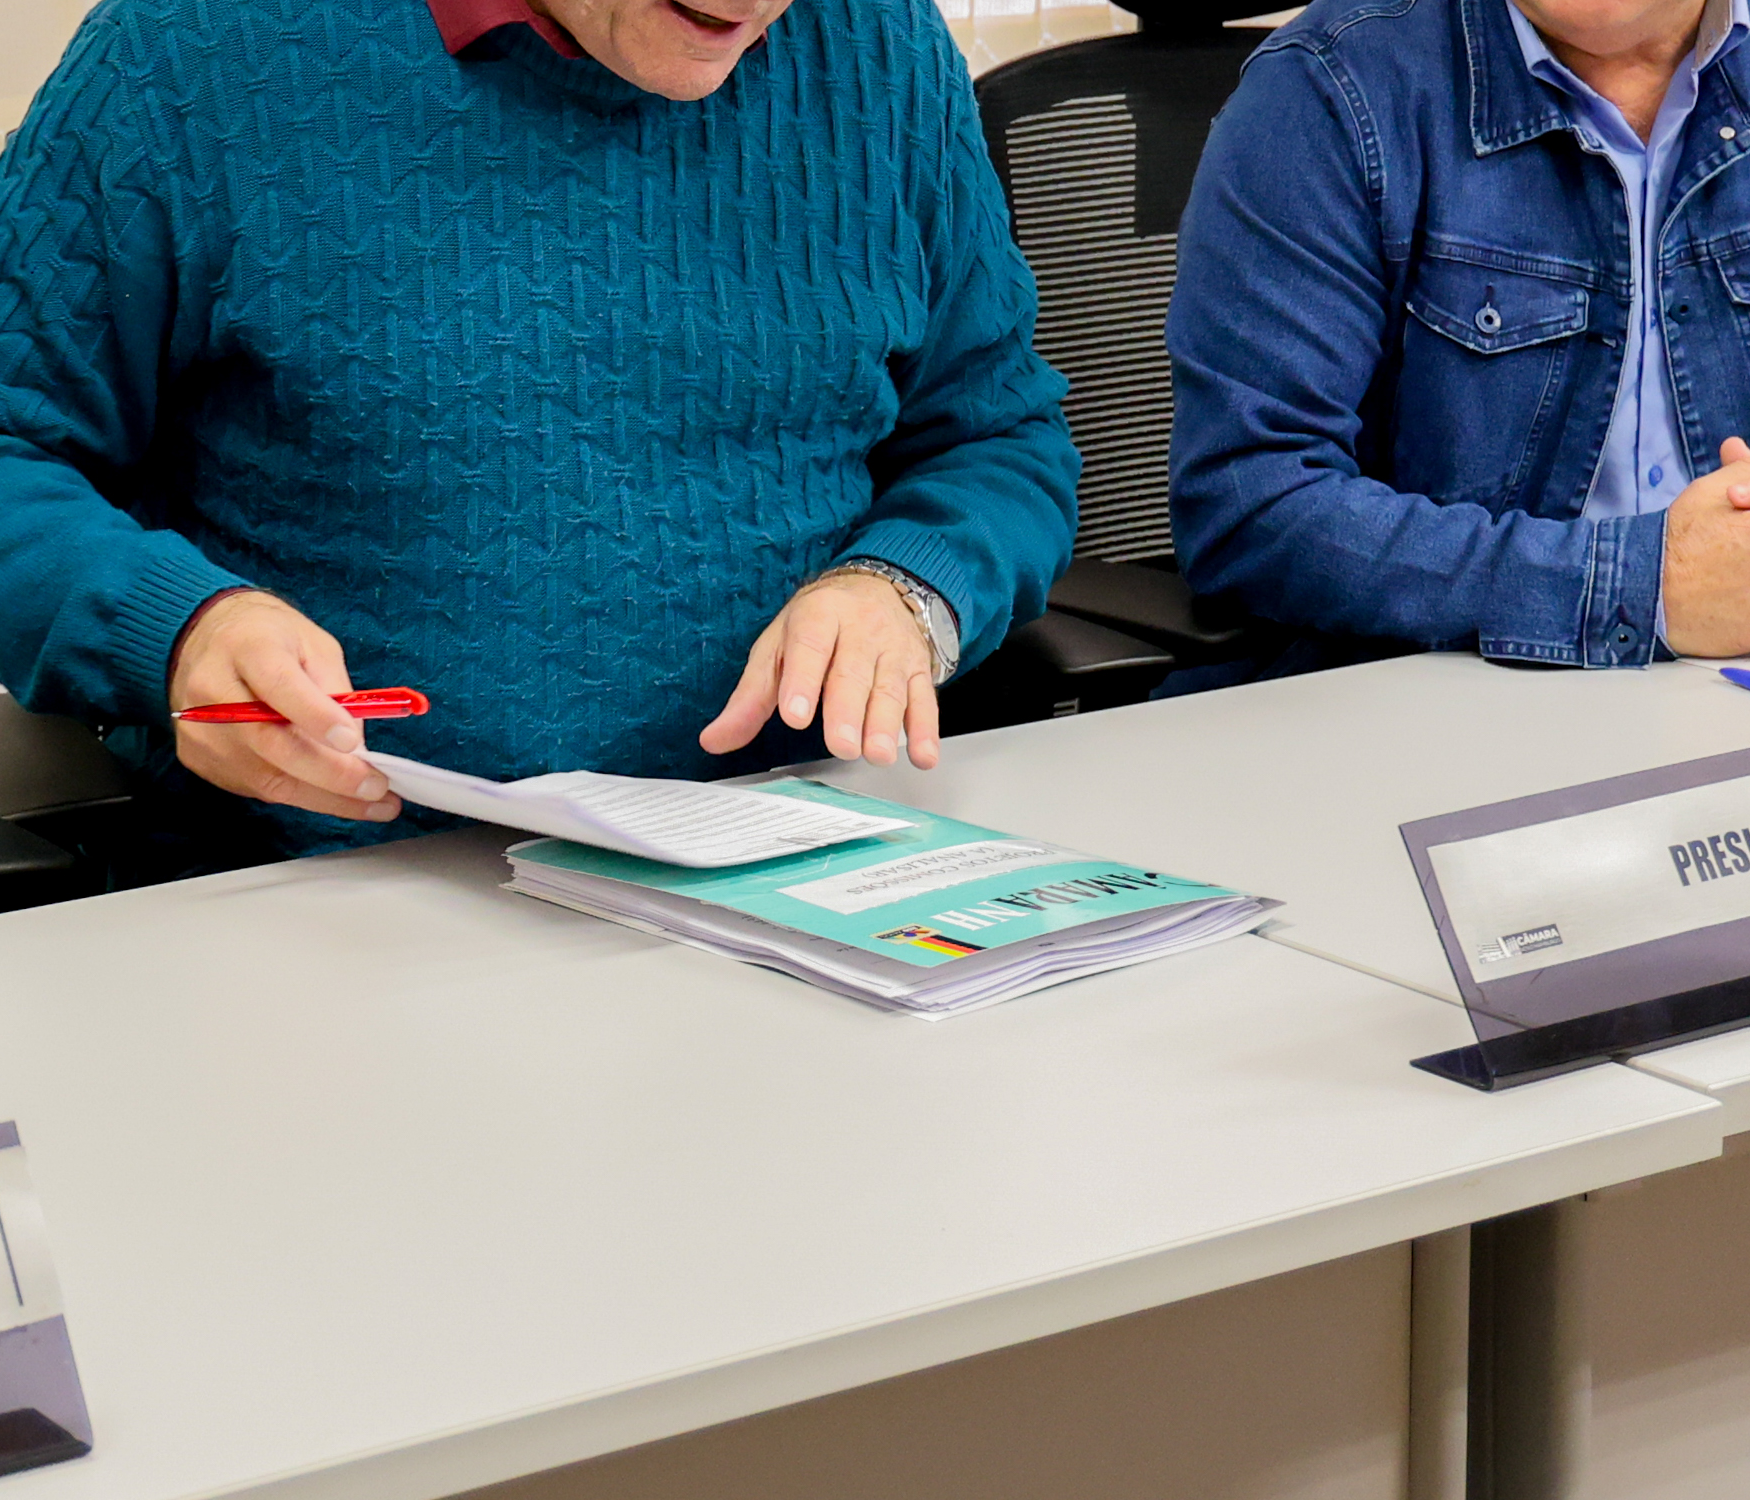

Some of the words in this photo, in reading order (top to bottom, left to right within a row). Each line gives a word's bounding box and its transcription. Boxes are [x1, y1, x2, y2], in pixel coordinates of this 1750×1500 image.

[846, 864, 959, 896] COMISSÕES
[861, 850, 968, 880] ANALISAR)
[1517, 928, 1560, 947] CÂMARA
